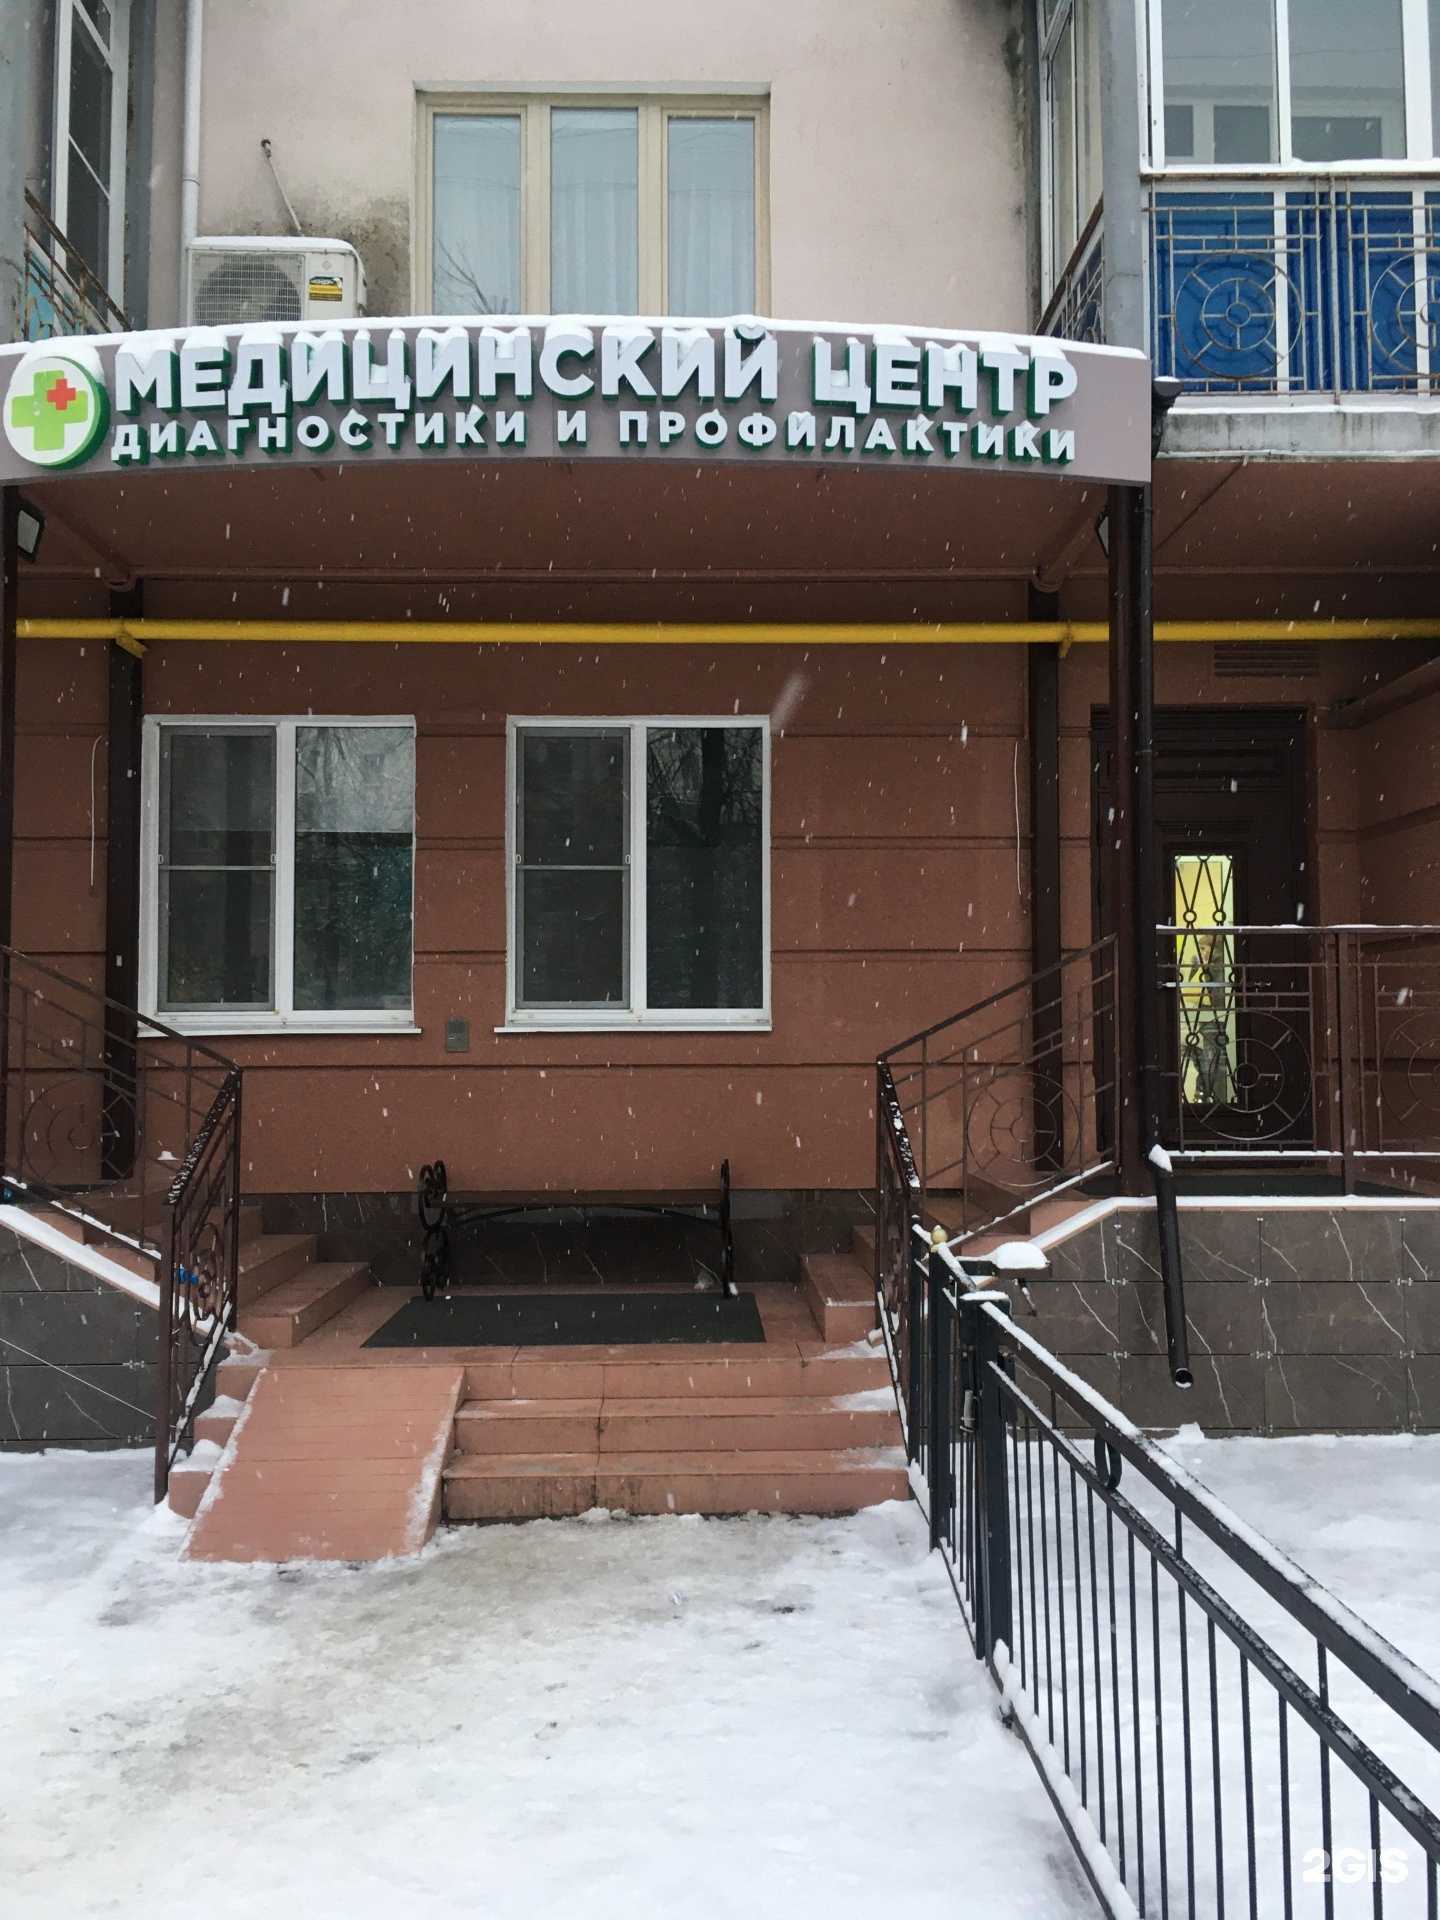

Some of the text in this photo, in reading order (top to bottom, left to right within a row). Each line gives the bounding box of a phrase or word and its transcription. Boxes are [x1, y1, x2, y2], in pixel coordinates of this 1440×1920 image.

[114, 324, 1079, 417] МЕДИЦИНСКИЙ ЦЕНТР
[111, 409, 1076, 463] ДИАГНОСТИКИ И ПРОФИЛАКТИКИ
